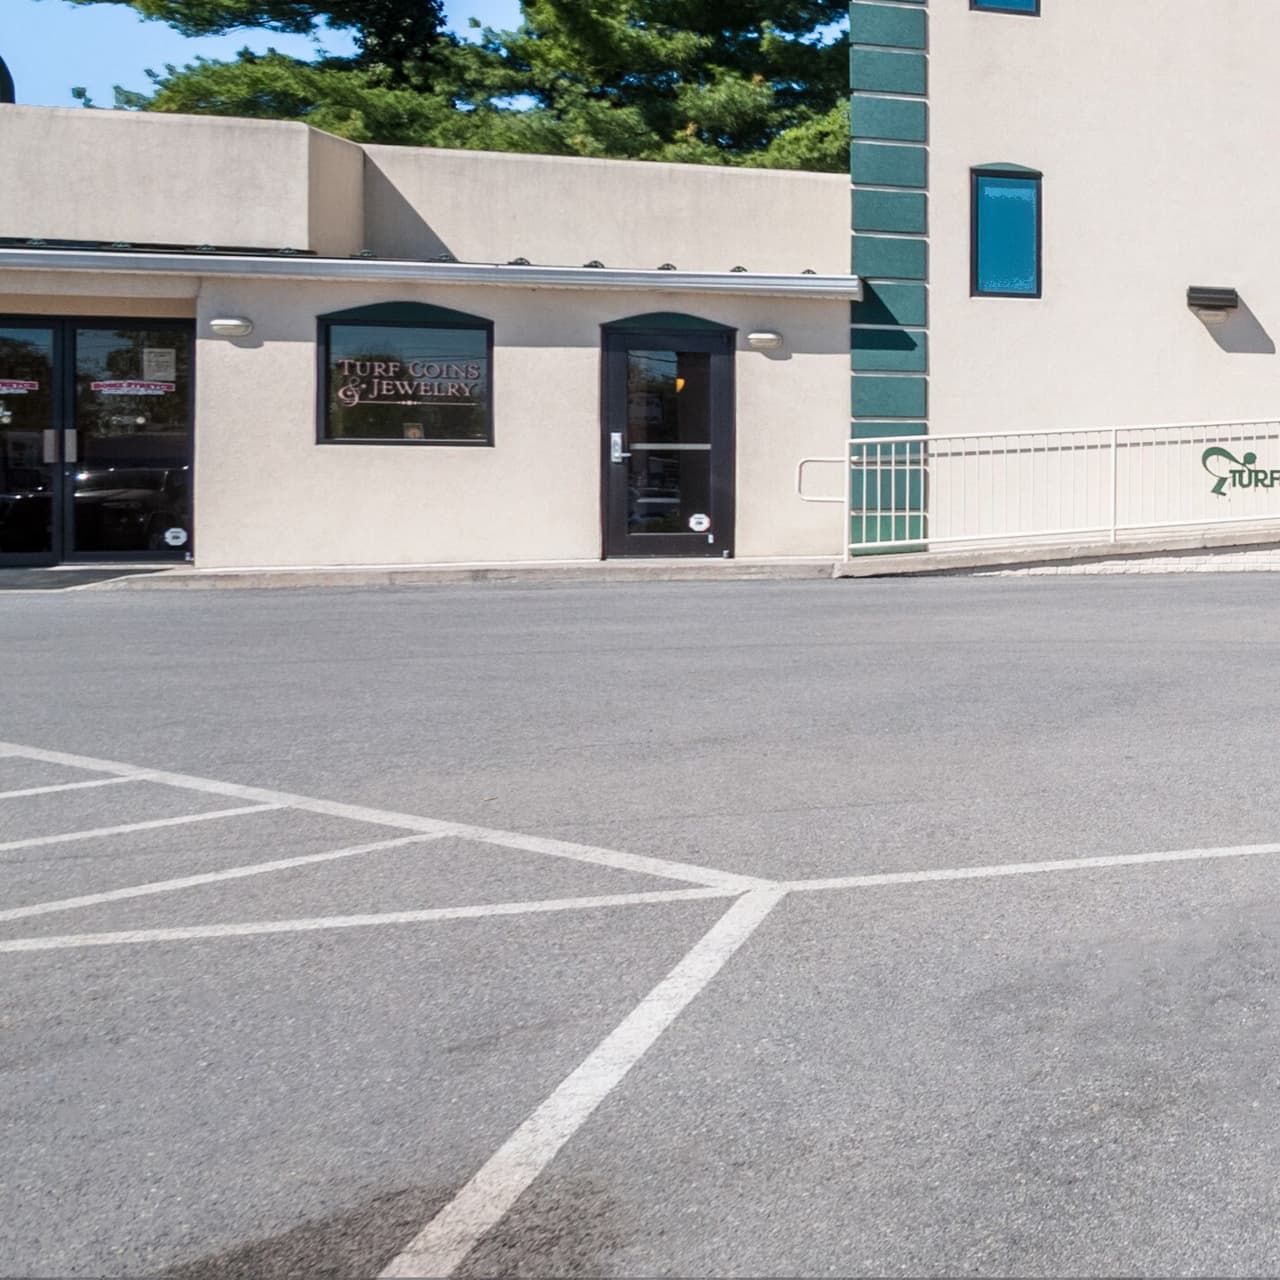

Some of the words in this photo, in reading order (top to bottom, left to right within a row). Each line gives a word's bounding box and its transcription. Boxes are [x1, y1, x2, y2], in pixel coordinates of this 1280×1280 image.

[337, 359, 400, 378] TURF
[408, 360, 480, 379] COINS
[337, 376, 366, 407] &
[369, 378, 475, 399] JEWELRY
[1229, 469, 1280, 488] TURF
